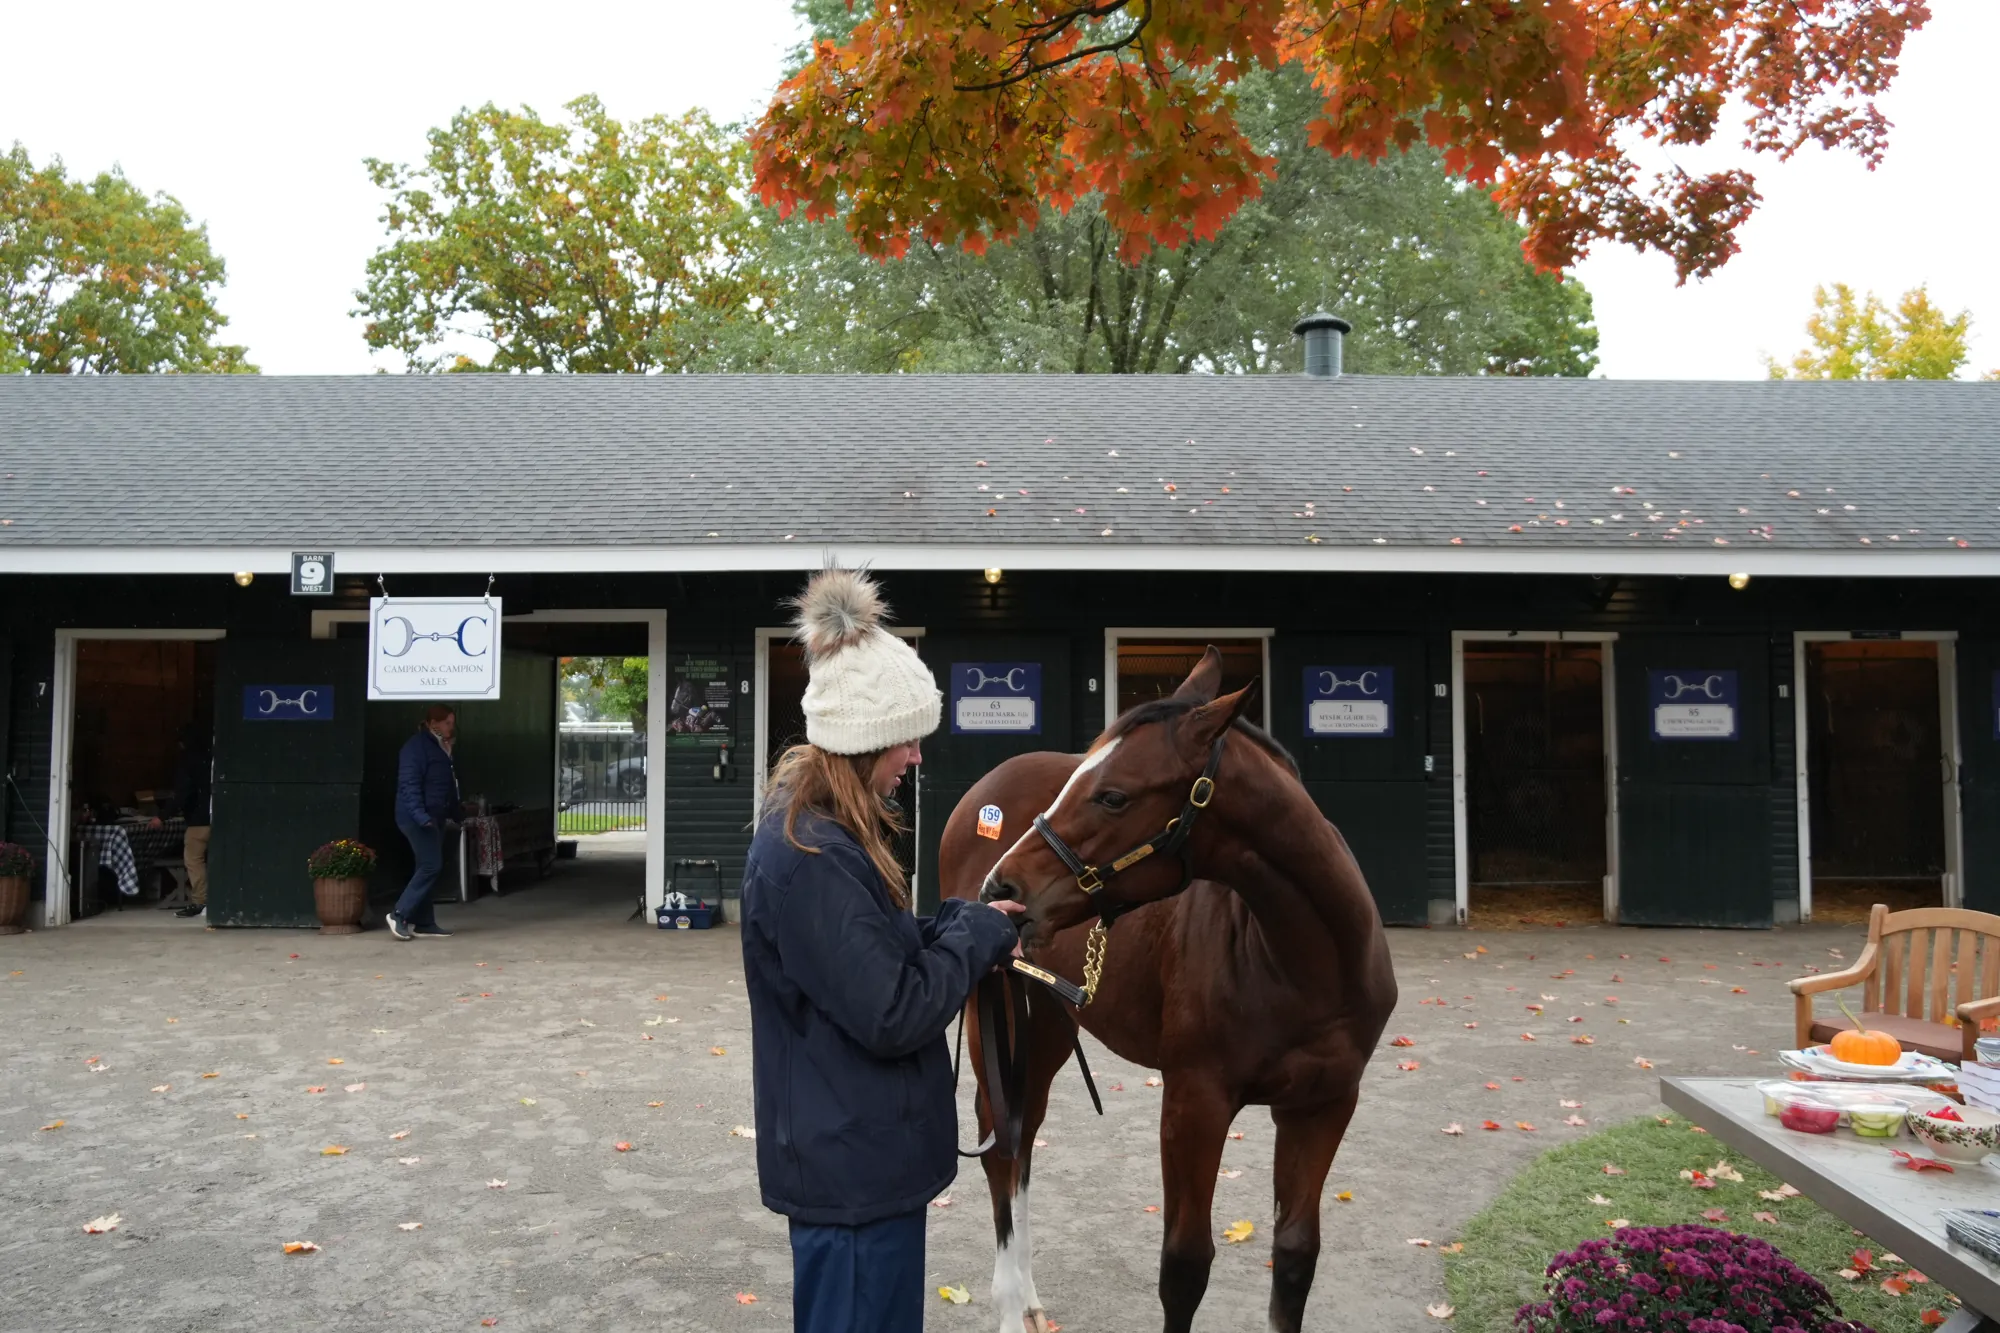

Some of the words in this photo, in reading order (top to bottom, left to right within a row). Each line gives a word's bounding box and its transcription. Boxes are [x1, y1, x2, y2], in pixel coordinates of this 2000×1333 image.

[300, 561, 325, 584] 9
[384, 664, 429, 673] CAMPION
[439, 664, 483, 673] CAMPION
[420, 677, 448, 686] SALES
[741, 680, 749, 694] 8
[1088, 678, 1097, 692] 9
[39, 682, 46, 696] 7
[1434, 683, 1447, 697] 10
[1778, 684, 1788, 698] 11
[990, 700, 1000, 709] 63
[1342, 704, 1352, 713] 71
[1688, 708, 1699, 717] 85
[983, 807, 1000, 822] 159
